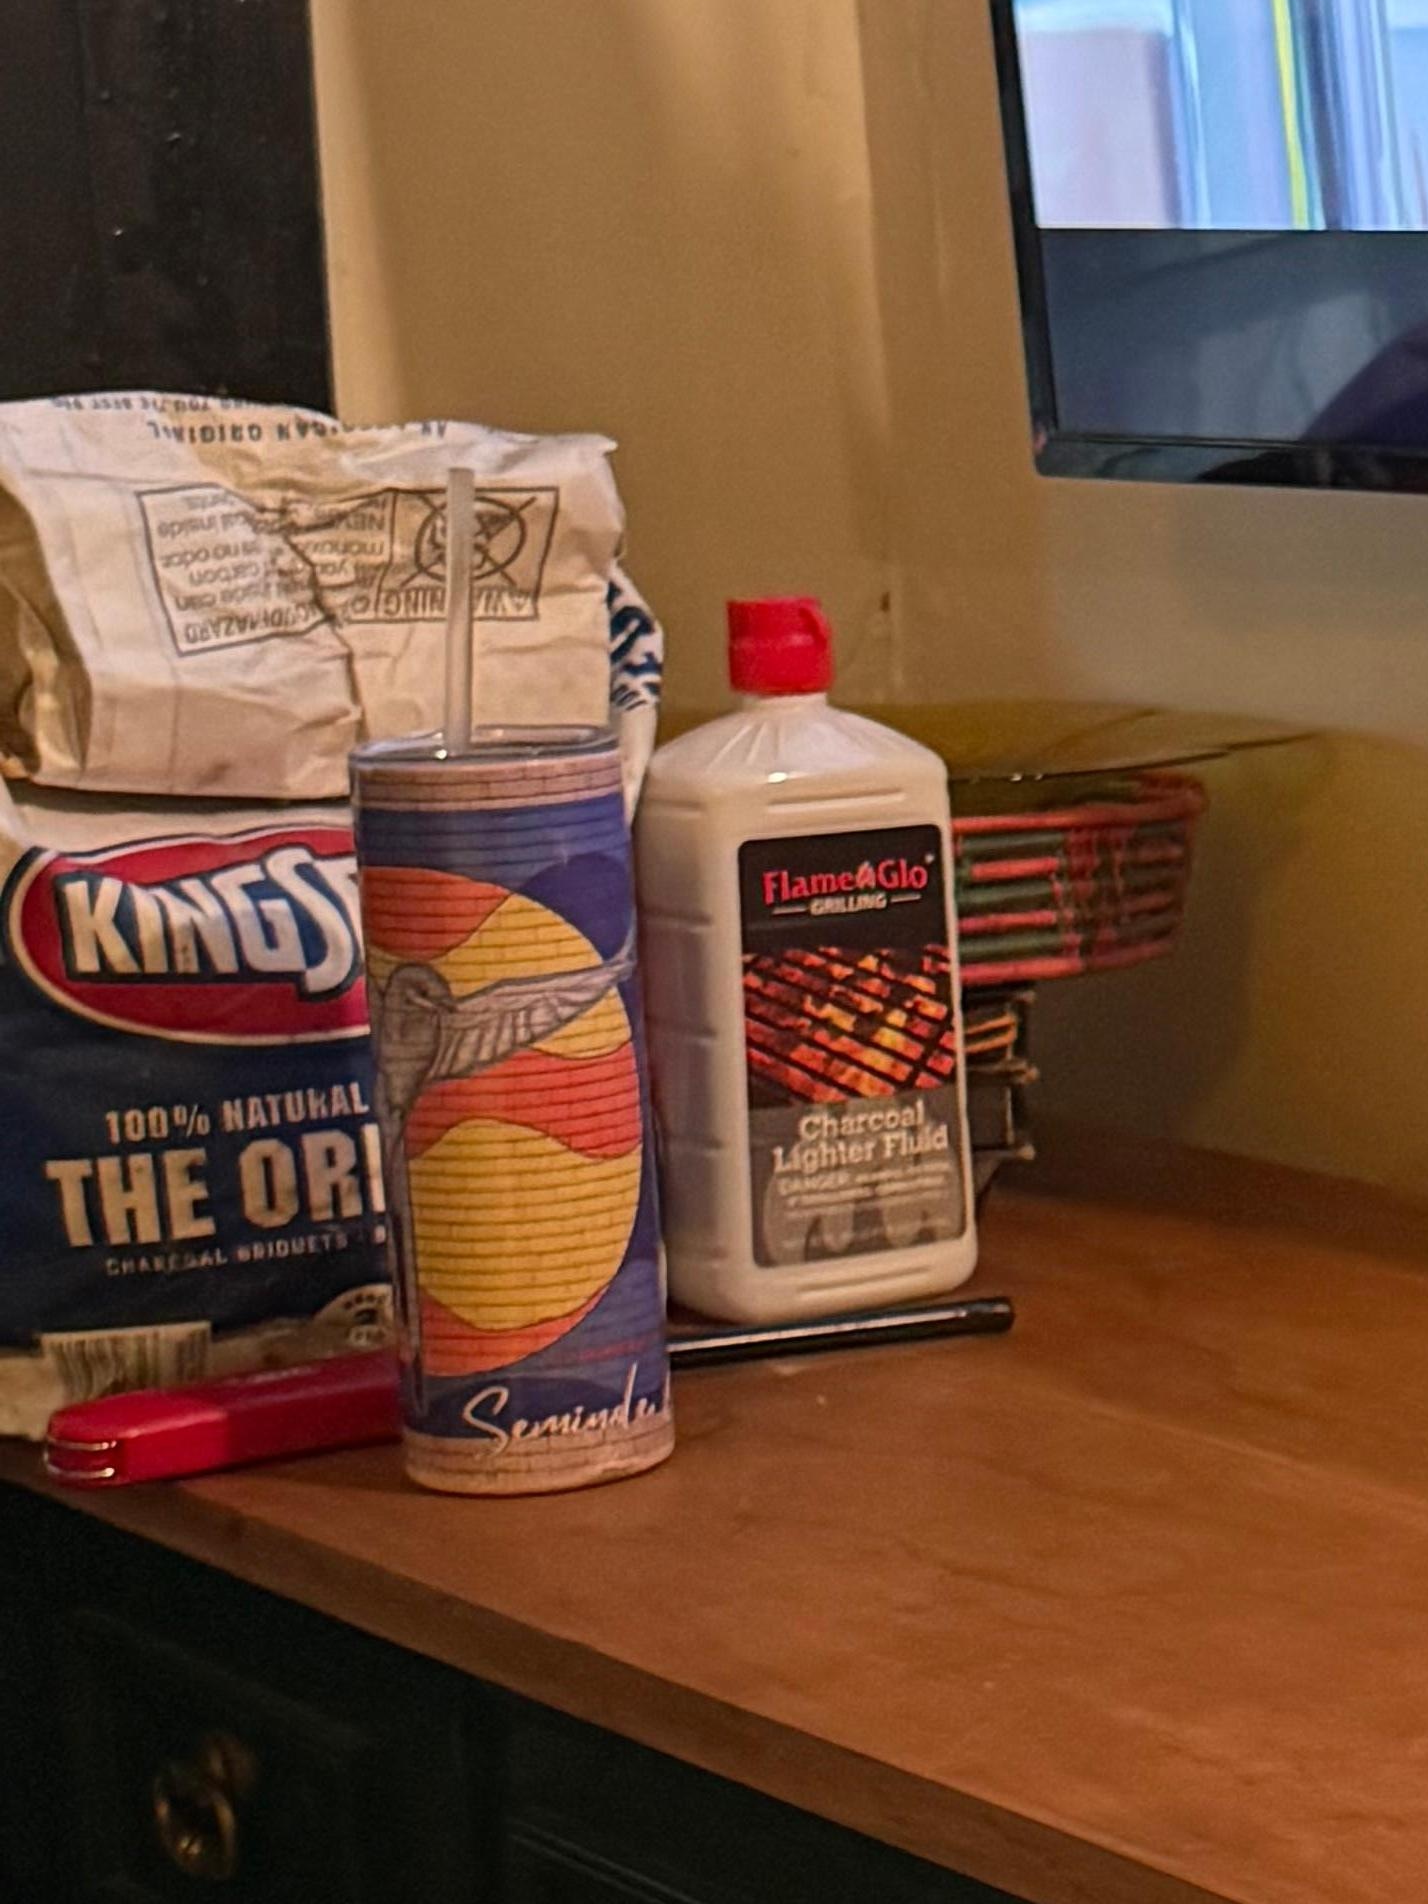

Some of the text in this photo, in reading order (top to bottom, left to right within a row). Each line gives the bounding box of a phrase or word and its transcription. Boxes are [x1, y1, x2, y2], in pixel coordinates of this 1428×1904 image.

[383, 588, 507, 616] WNING
[762, 858, 928, 907] Flame Glo
[104, 1081, 371, 1145] 100% NATURAL
[799, 1099, 924, 1141] Charcoal
[773, 1140, 878, 1175] Lighter
[882, 1124, 948, 1159] Fluid
[45, 1147, 216, 1247] THE
